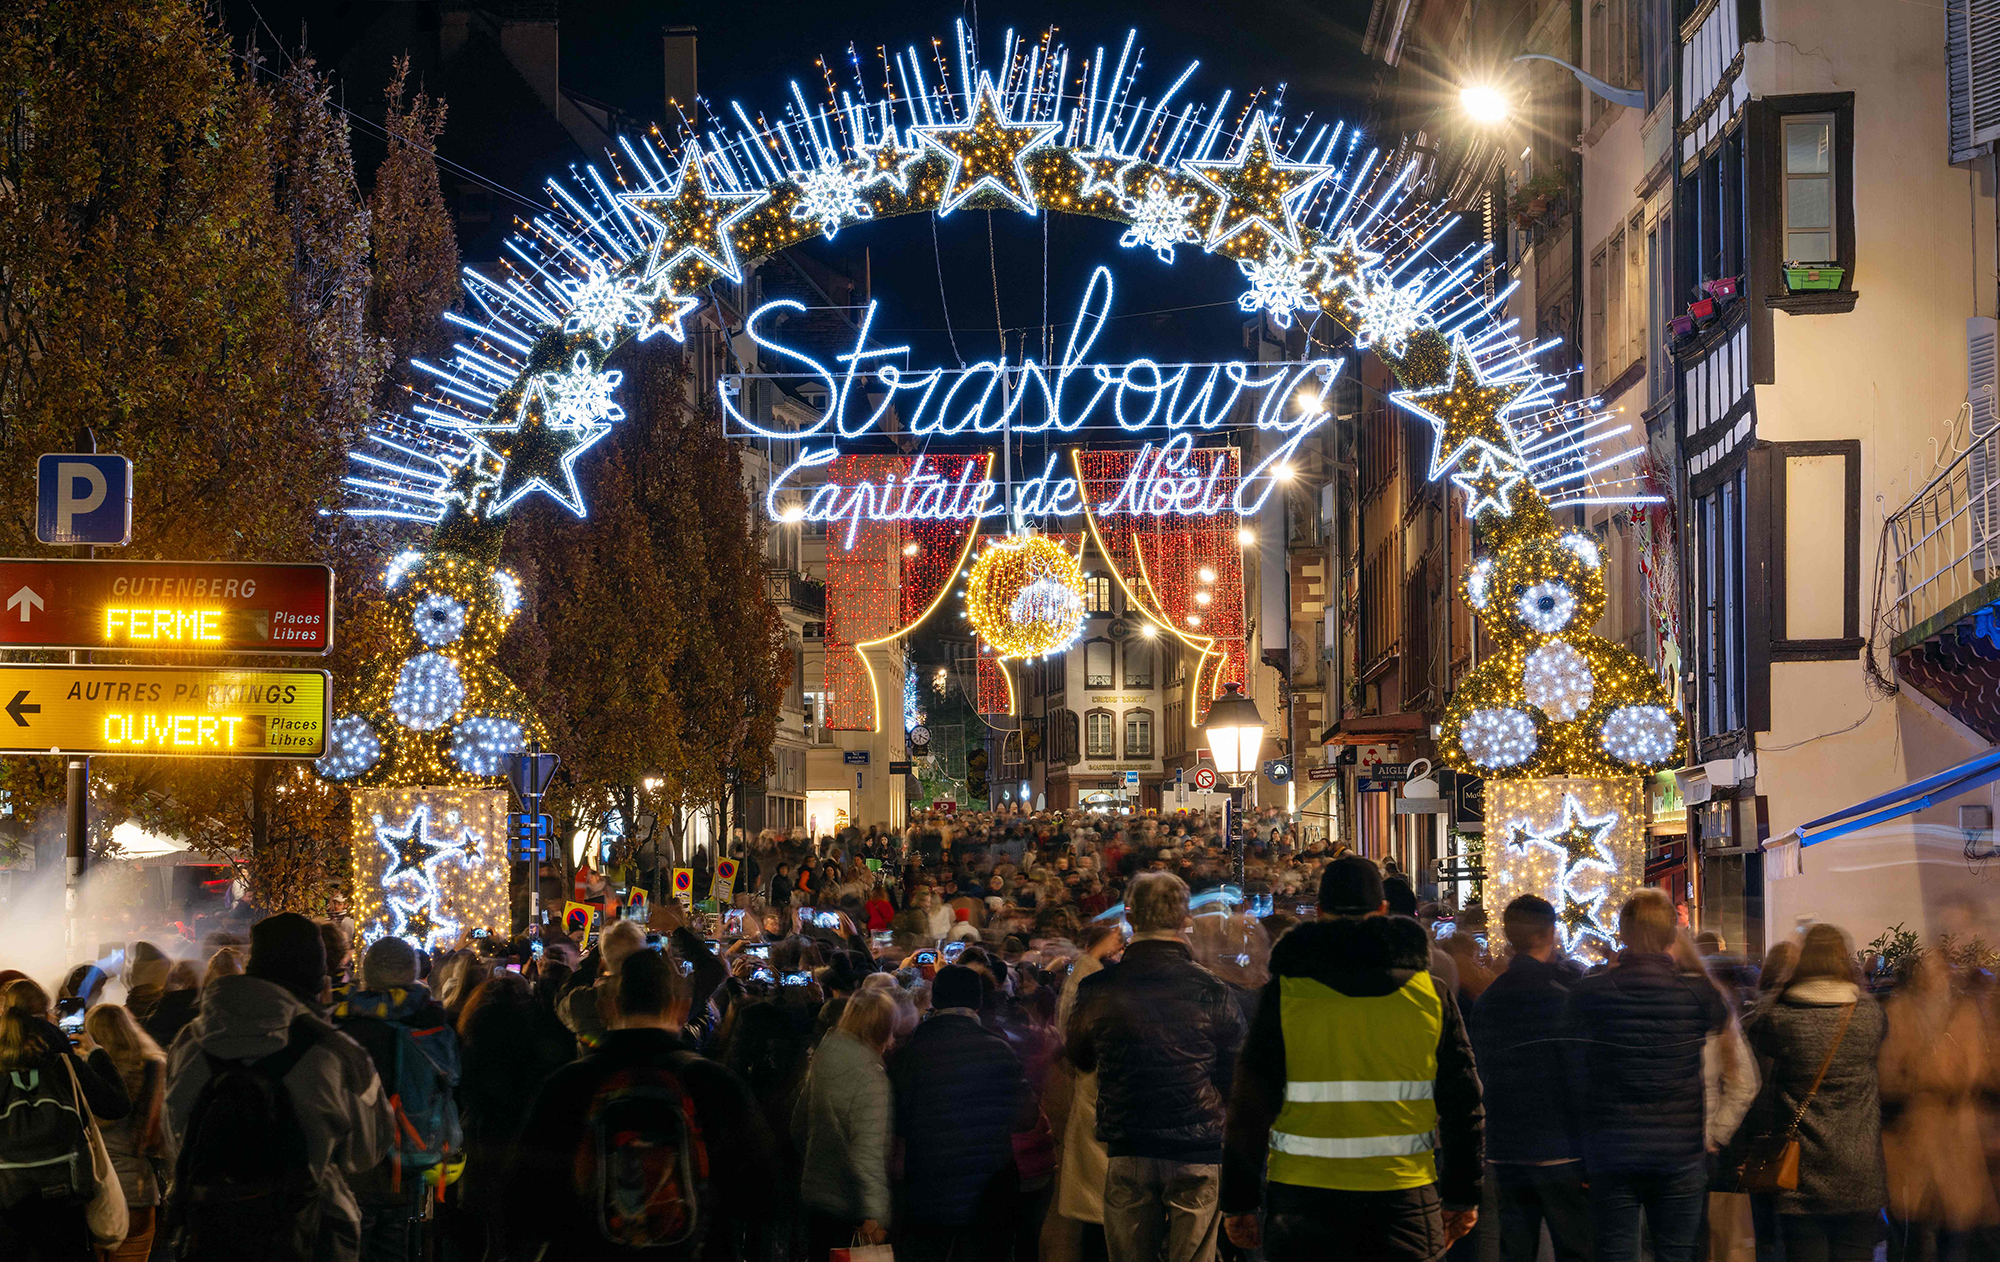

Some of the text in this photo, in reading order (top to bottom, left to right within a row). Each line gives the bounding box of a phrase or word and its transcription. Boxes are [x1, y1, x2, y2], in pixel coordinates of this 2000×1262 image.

[717, 266, 1346, 516] Strasbourg
[57, 462, 107, 535] P
[766, 433, 1231, 551] Capitale de Noël
[112, 576, 257, 598] GUTENBERG
[105, 607, 223, 642] FERME
[273, 611, 321, 625] Places
[273, 627, 318, 641] Libres
[66, 681, 298, 705] AUTRES PARKINGS
[103, 713, 243, 747] OUVERT
[270, 717, 319, 731] Places
[270, 733, 315, 747] Libres
[1378, 766, 1408, 775] AIGLE
